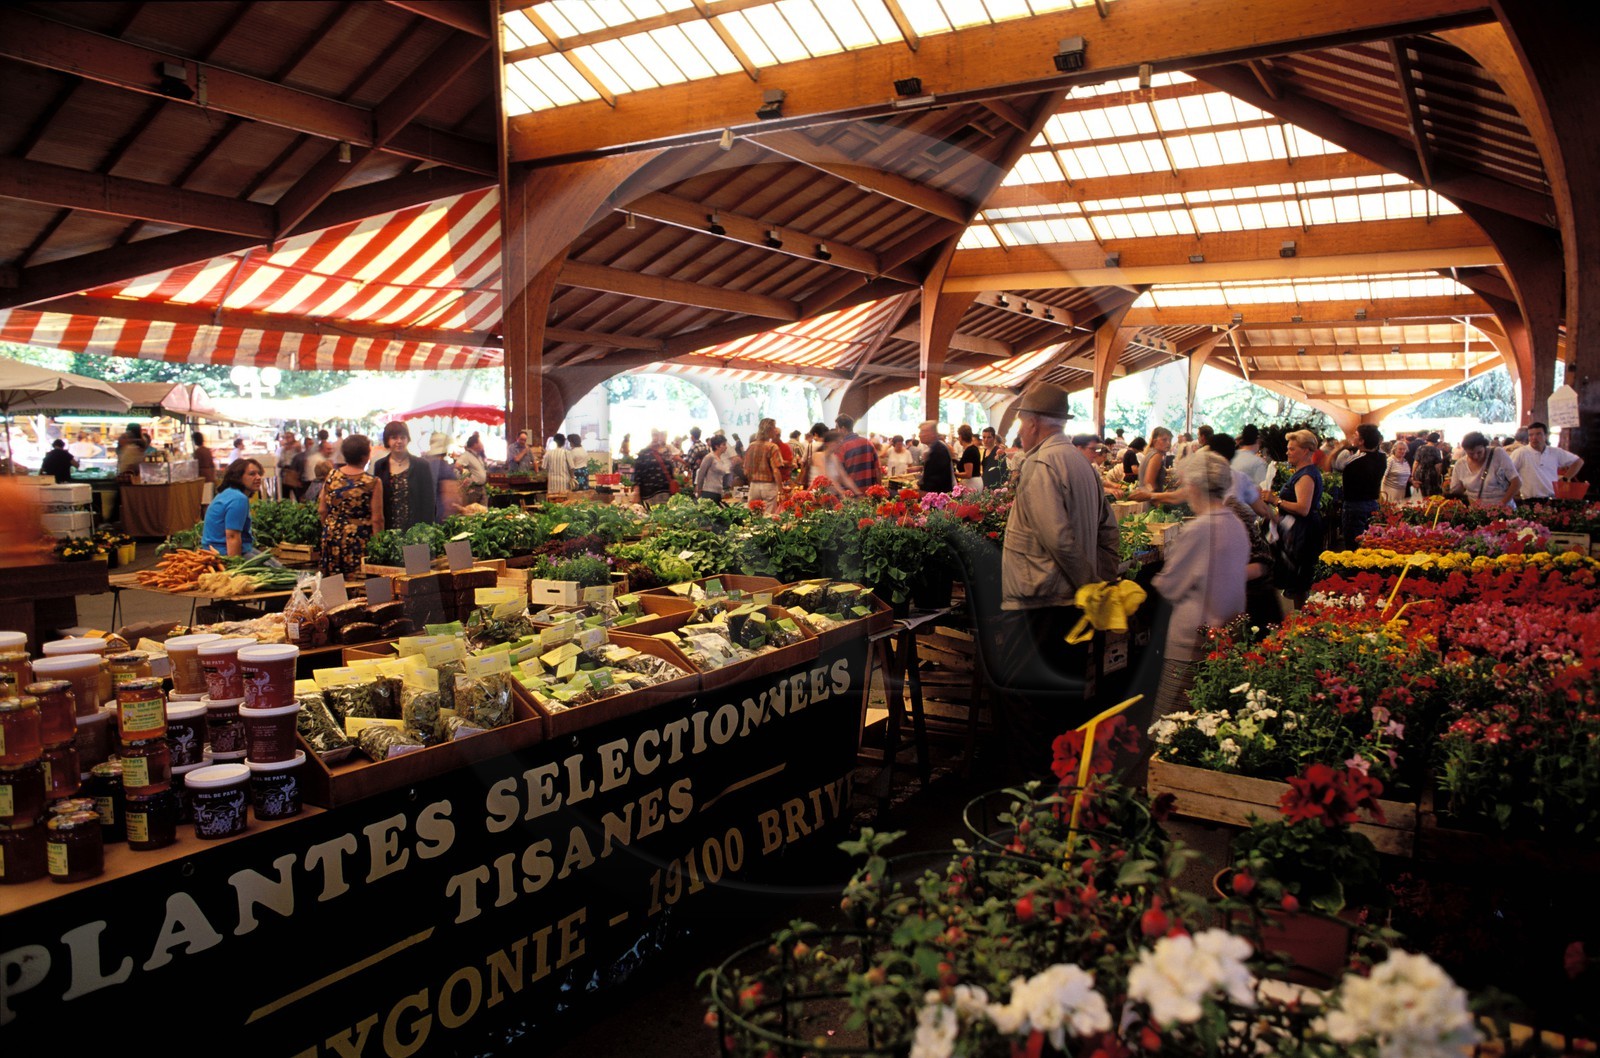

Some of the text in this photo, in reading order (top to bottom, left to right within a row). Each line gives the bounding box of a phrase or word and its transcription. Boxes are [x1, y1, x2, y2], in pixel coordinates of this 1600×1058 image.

[0, 658, 851, 1027] PLANTES SELECTIONNEES
[222, 789, 237, 797] PAYS
[445, 777, 694, 925] TISANES
[290, 906, 588, 1058] YGONIE
[647, 827, 744, 917] 19100
